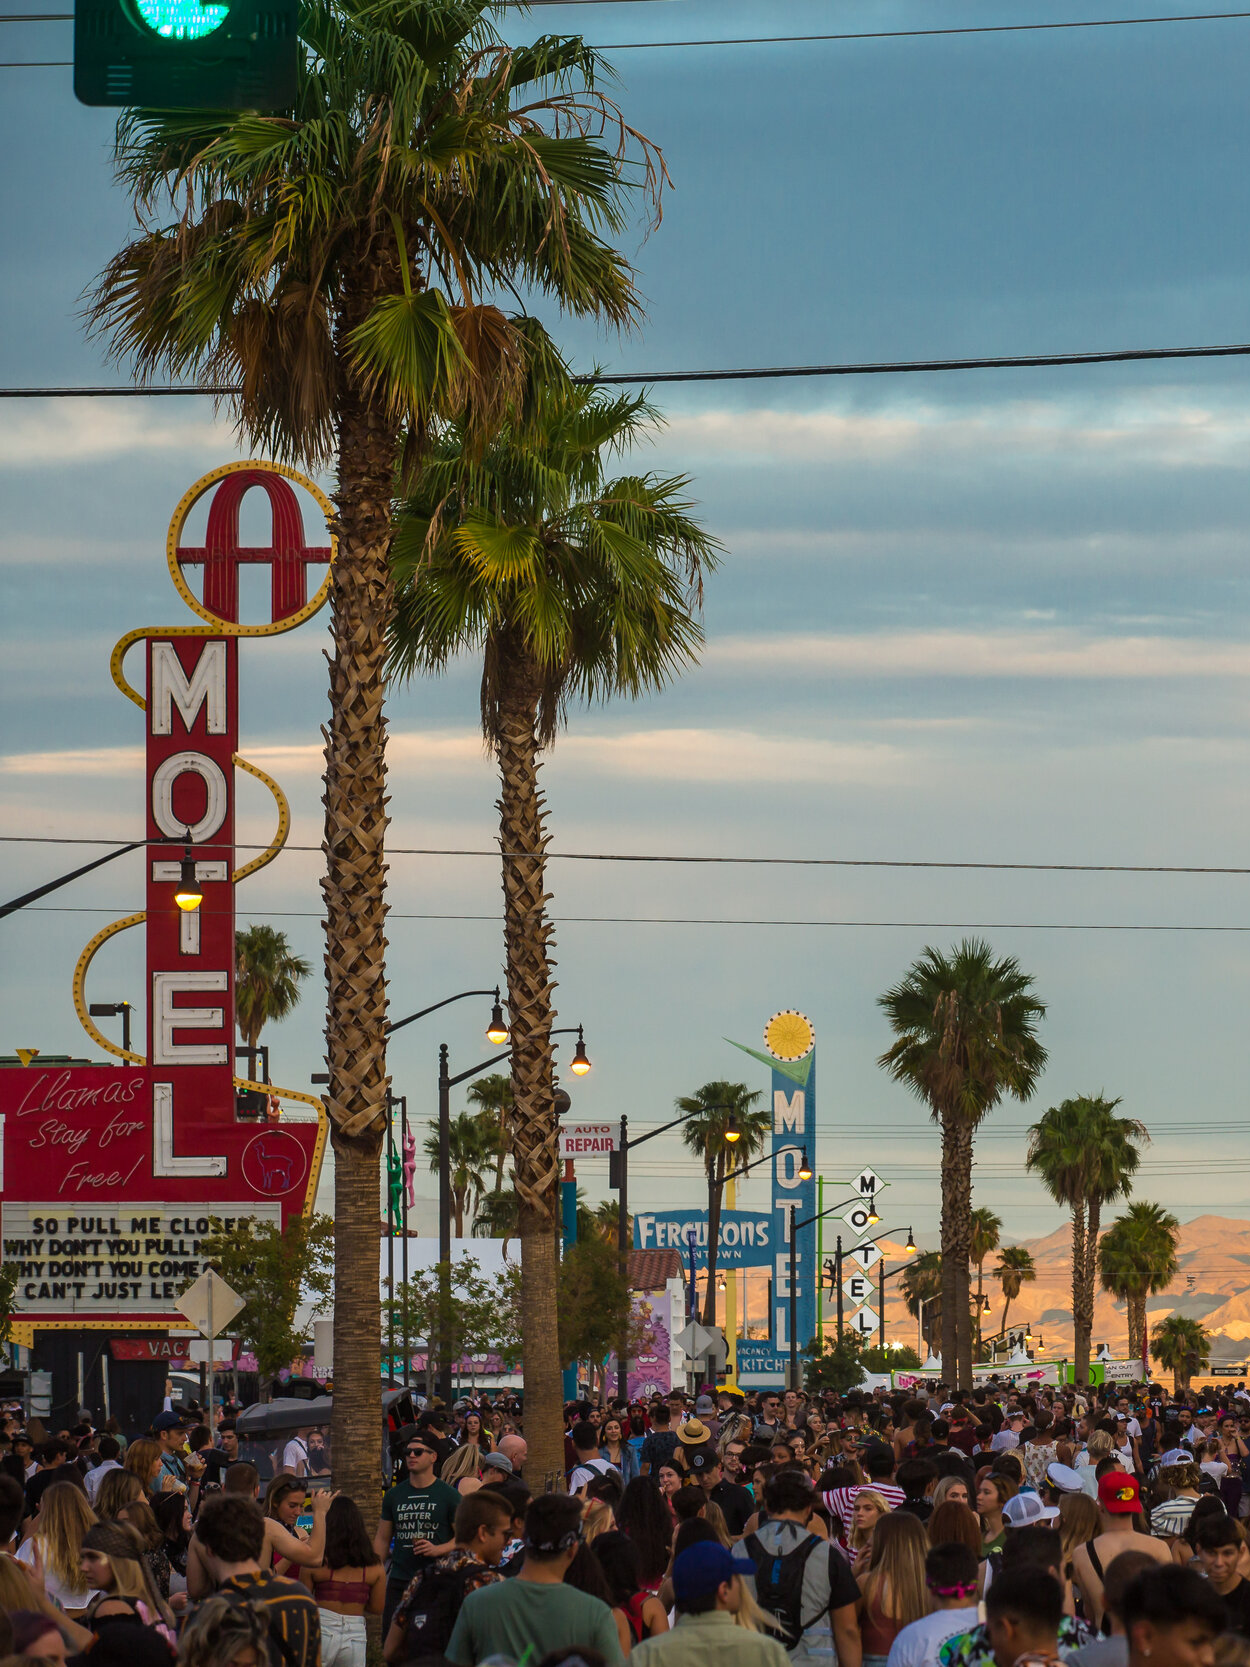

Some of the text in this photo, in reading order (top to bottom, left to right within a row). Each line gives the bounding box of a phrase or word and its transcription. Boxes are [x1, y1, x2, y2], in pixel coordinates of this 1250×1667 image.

[152, 641, 228, 1179] MOTEL
[29, 1109, 145, 1155] Stay for
[574, 1126, 610, 1135] AUTO
[565, 1137, 614, 1152] REPAIR
[58, 1154, 145, 1194] Free!
[33, 1217, 59, 1235] SO
[67, 1217, 122, 1235] PULL
[131, 1217, 161, 1234] ME
[773, 1089, 805, 1352] MOTEL
[3, 1239, 45, 1256] WHY
[49, 1239, 105, 1256] DON'T
[106, 1239, 141, 1256] YOU
[145, 1239, 190, 1256] PULL
[850, 1175, 876, 1332] MOTEL
[49, 1261, 105, 1278] DON'T
[109, 1261, 143, 1278] YOU
[148, 1261, 199, 1278] COME
[25, 1282, 86, 1299] CAN'T
[92, 1282, 143, 1299] JUST
[396, 1502, 437, 1512] LEAVE IT
[398, 1512, 431, 1521] BETTER
[418, 1522, 440, 1530] YOU
[427, 1531, 435, 1540] IT
